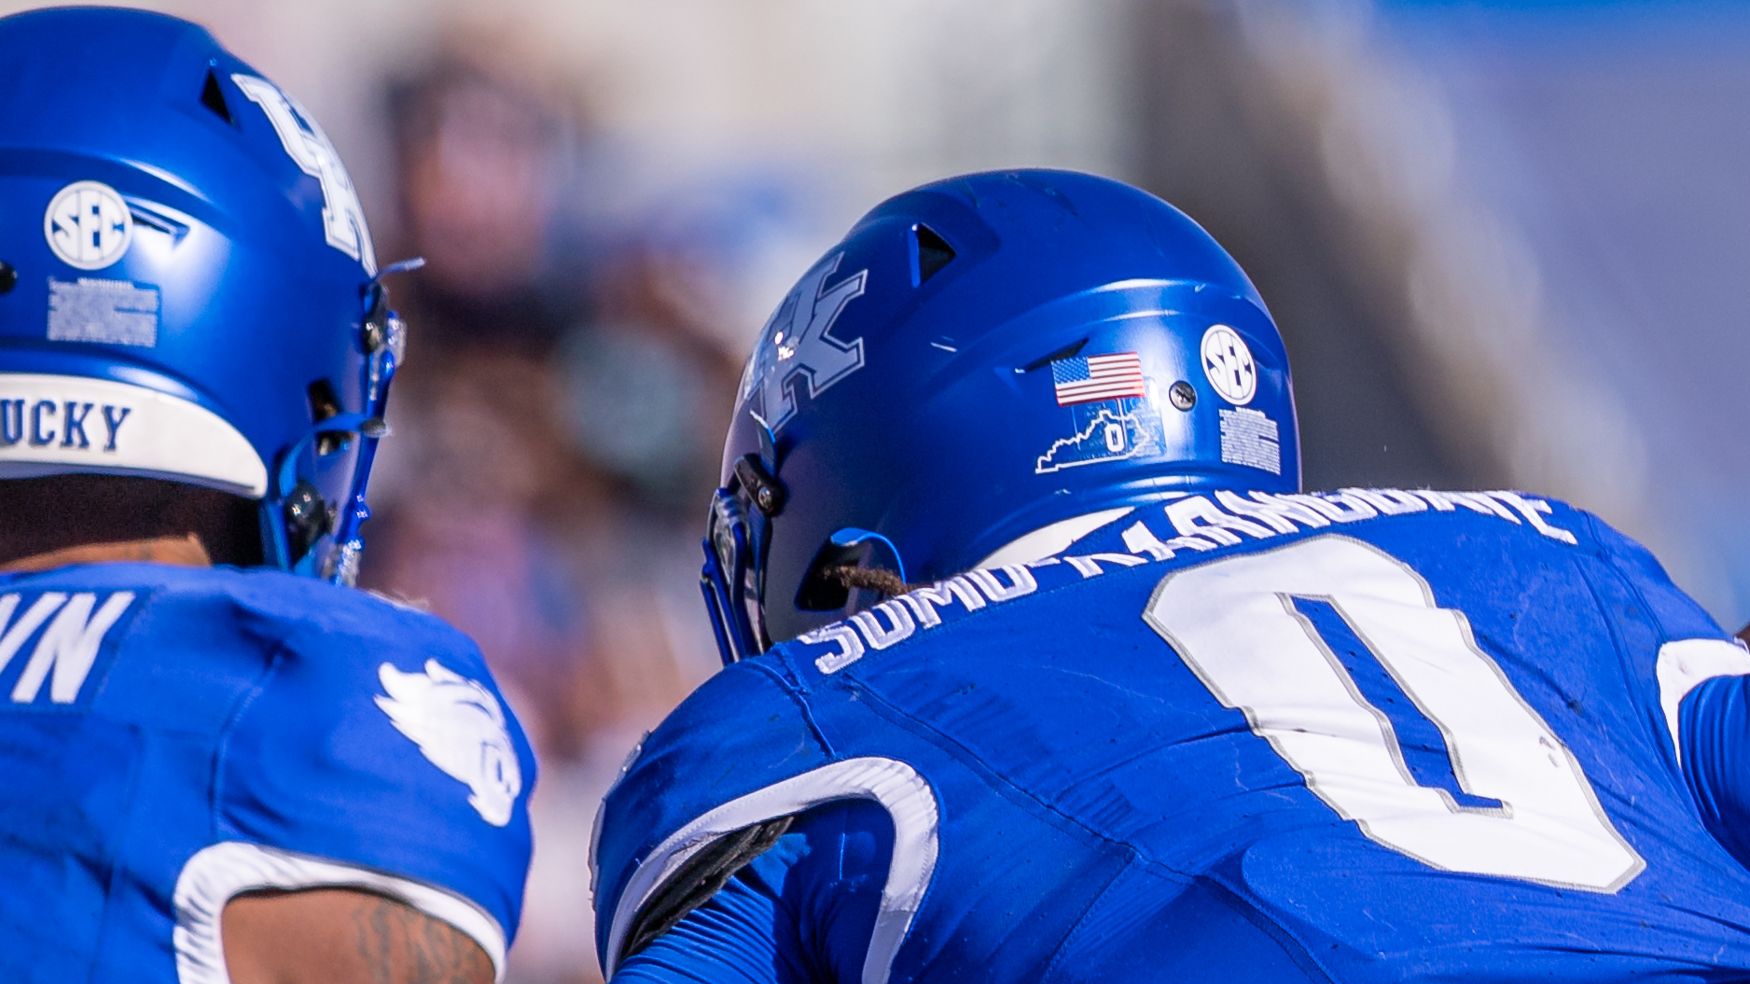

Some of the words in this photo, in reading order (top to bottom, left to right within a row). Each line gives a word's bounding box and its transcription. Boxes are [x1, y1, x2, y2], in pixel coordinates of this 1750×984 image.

[51, 187, 128, 265] SEC
[1203, 327, 1256, 403] SEC
[1104, 423, 1125, 453] 0
[1141, 533, 1647, 895] 0
